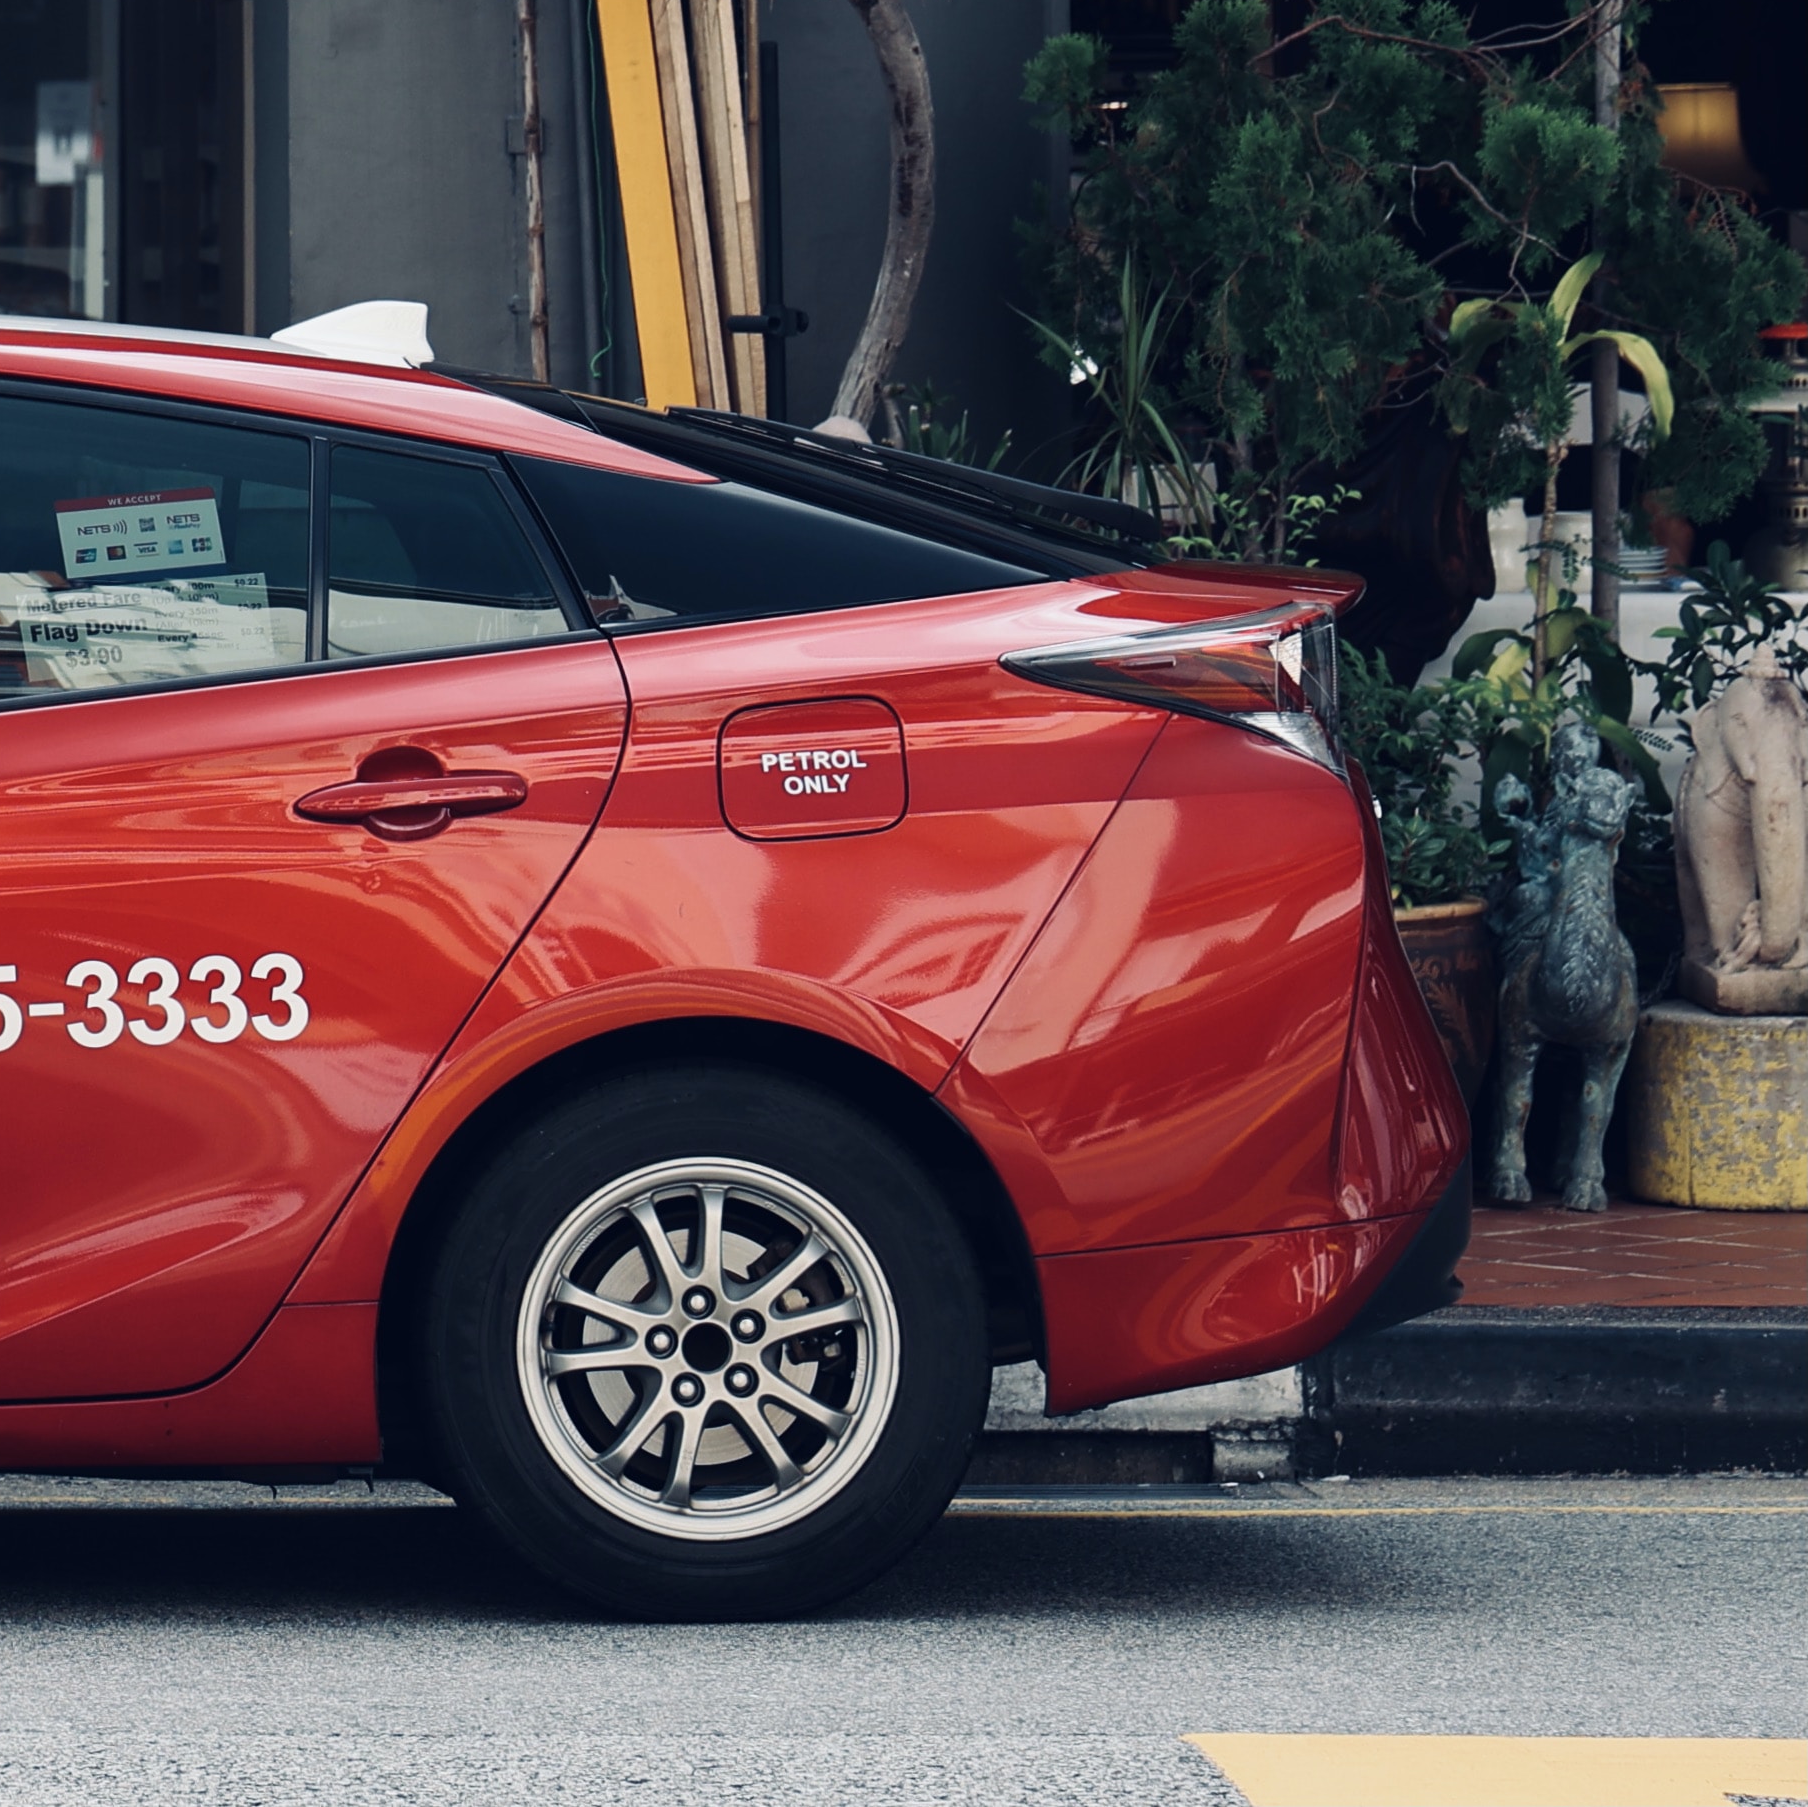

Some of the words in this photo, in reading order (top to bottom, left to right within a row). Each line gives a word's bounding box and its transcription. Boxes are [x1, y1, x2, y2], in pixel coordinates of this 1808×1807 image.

[107, 498, 123, 507] WE
[125, 493, 162, 506] ACCEPT
[167, 513, 201, 525] NETS
[77, 524, 112, 537] NETS
[137, 546, 157, 555] VISA
[27, 594, 98, 614] Metered
[102, 591, 143, 608] Fare
[30, 621, 79, 644] Flag
[86, 617, 148, 638] Down
[65, 645, 123, 668] $3.90
[761, 750, 867, 773] PETROL
[784, 774, 850, 796] ONLY
